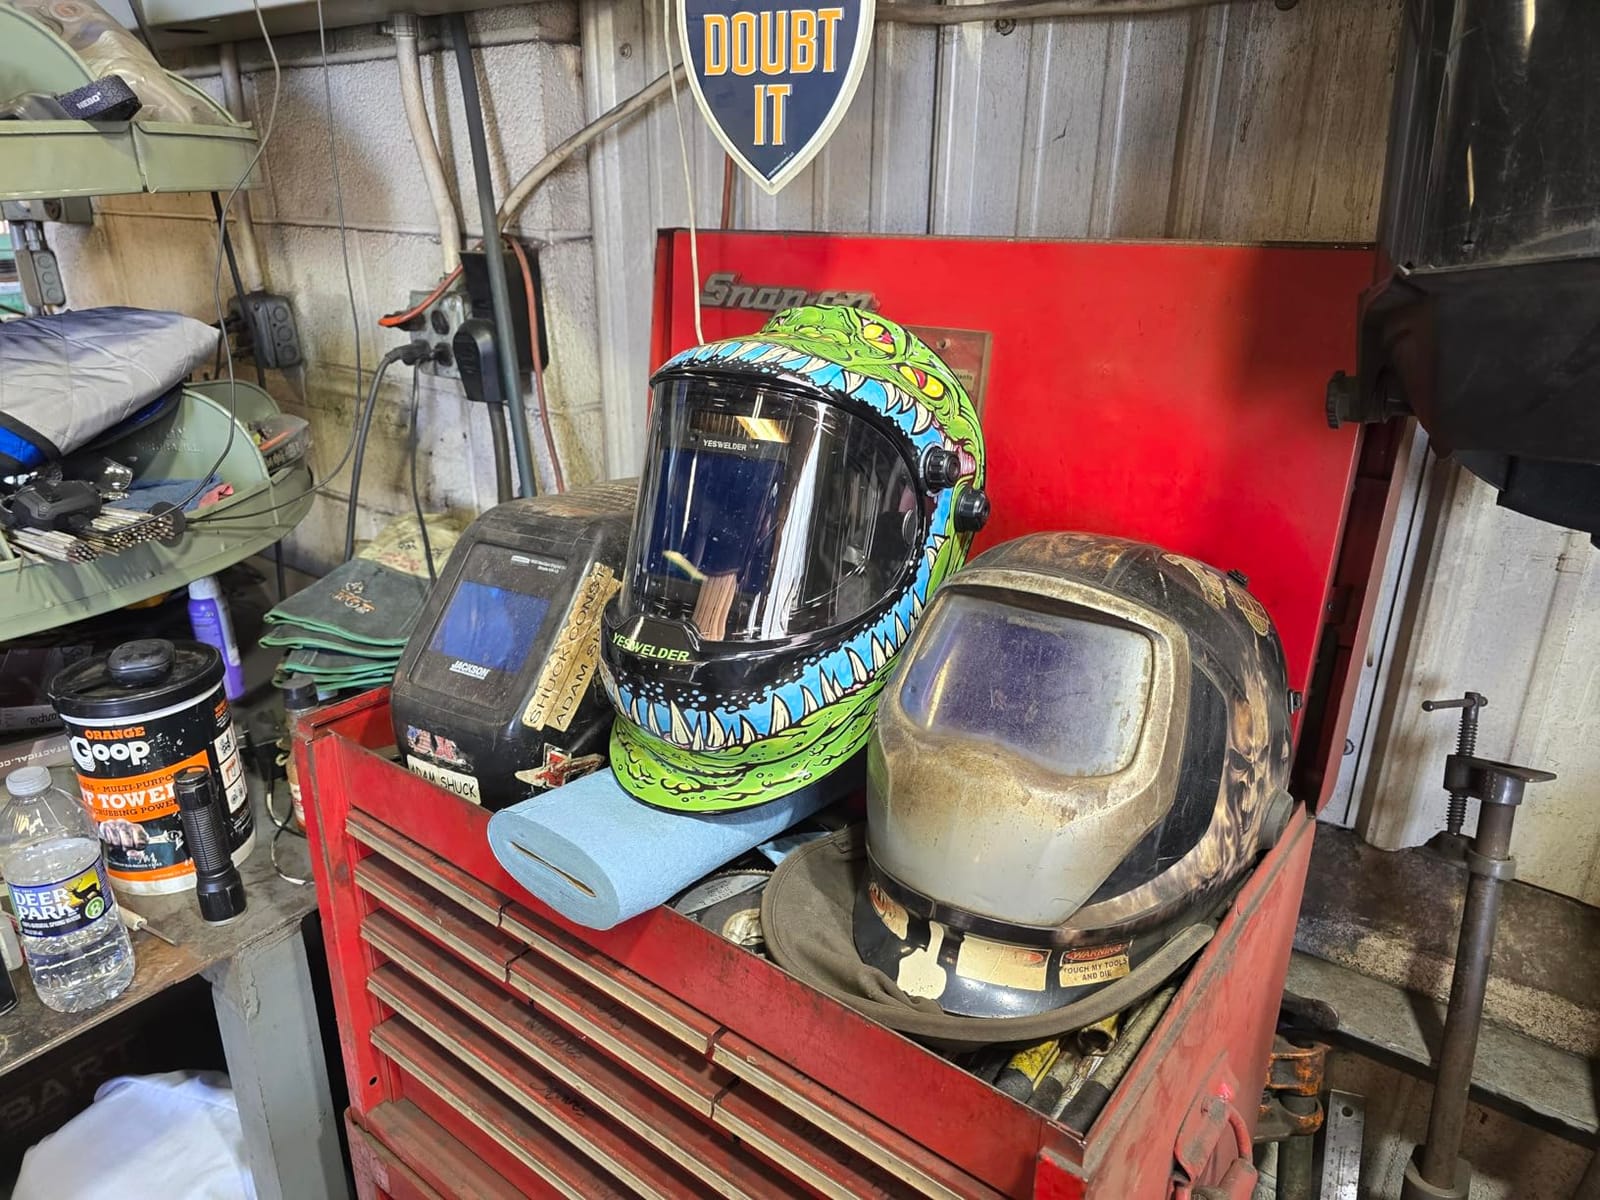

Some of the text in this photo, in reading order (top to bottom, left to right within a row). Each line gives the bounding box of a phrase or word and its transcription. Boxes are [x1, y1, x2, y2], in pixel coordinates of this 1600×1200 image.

[704, 8, 844, 76] DOUBT
[754, 84, 792, 145] IT
[703, 439, 747, 451] YESWELDER
[612, 632, 690, 662] YESWELDER
[449, 660, 490, 680] JACKSON
[529, 647, 570, 725] SHUCK
[556, 663, 589, 726] ADAM
[85, 726, 146, 741] ORANGE
[103, 774, 174, 794] MULTI-PURPO
[440, 775, 477, 798] SHUCK
[94, 807, 138, 818] CRUBBING
[13, 888, 71, 907] DEER
[18, 900, 77, 921] PARK
